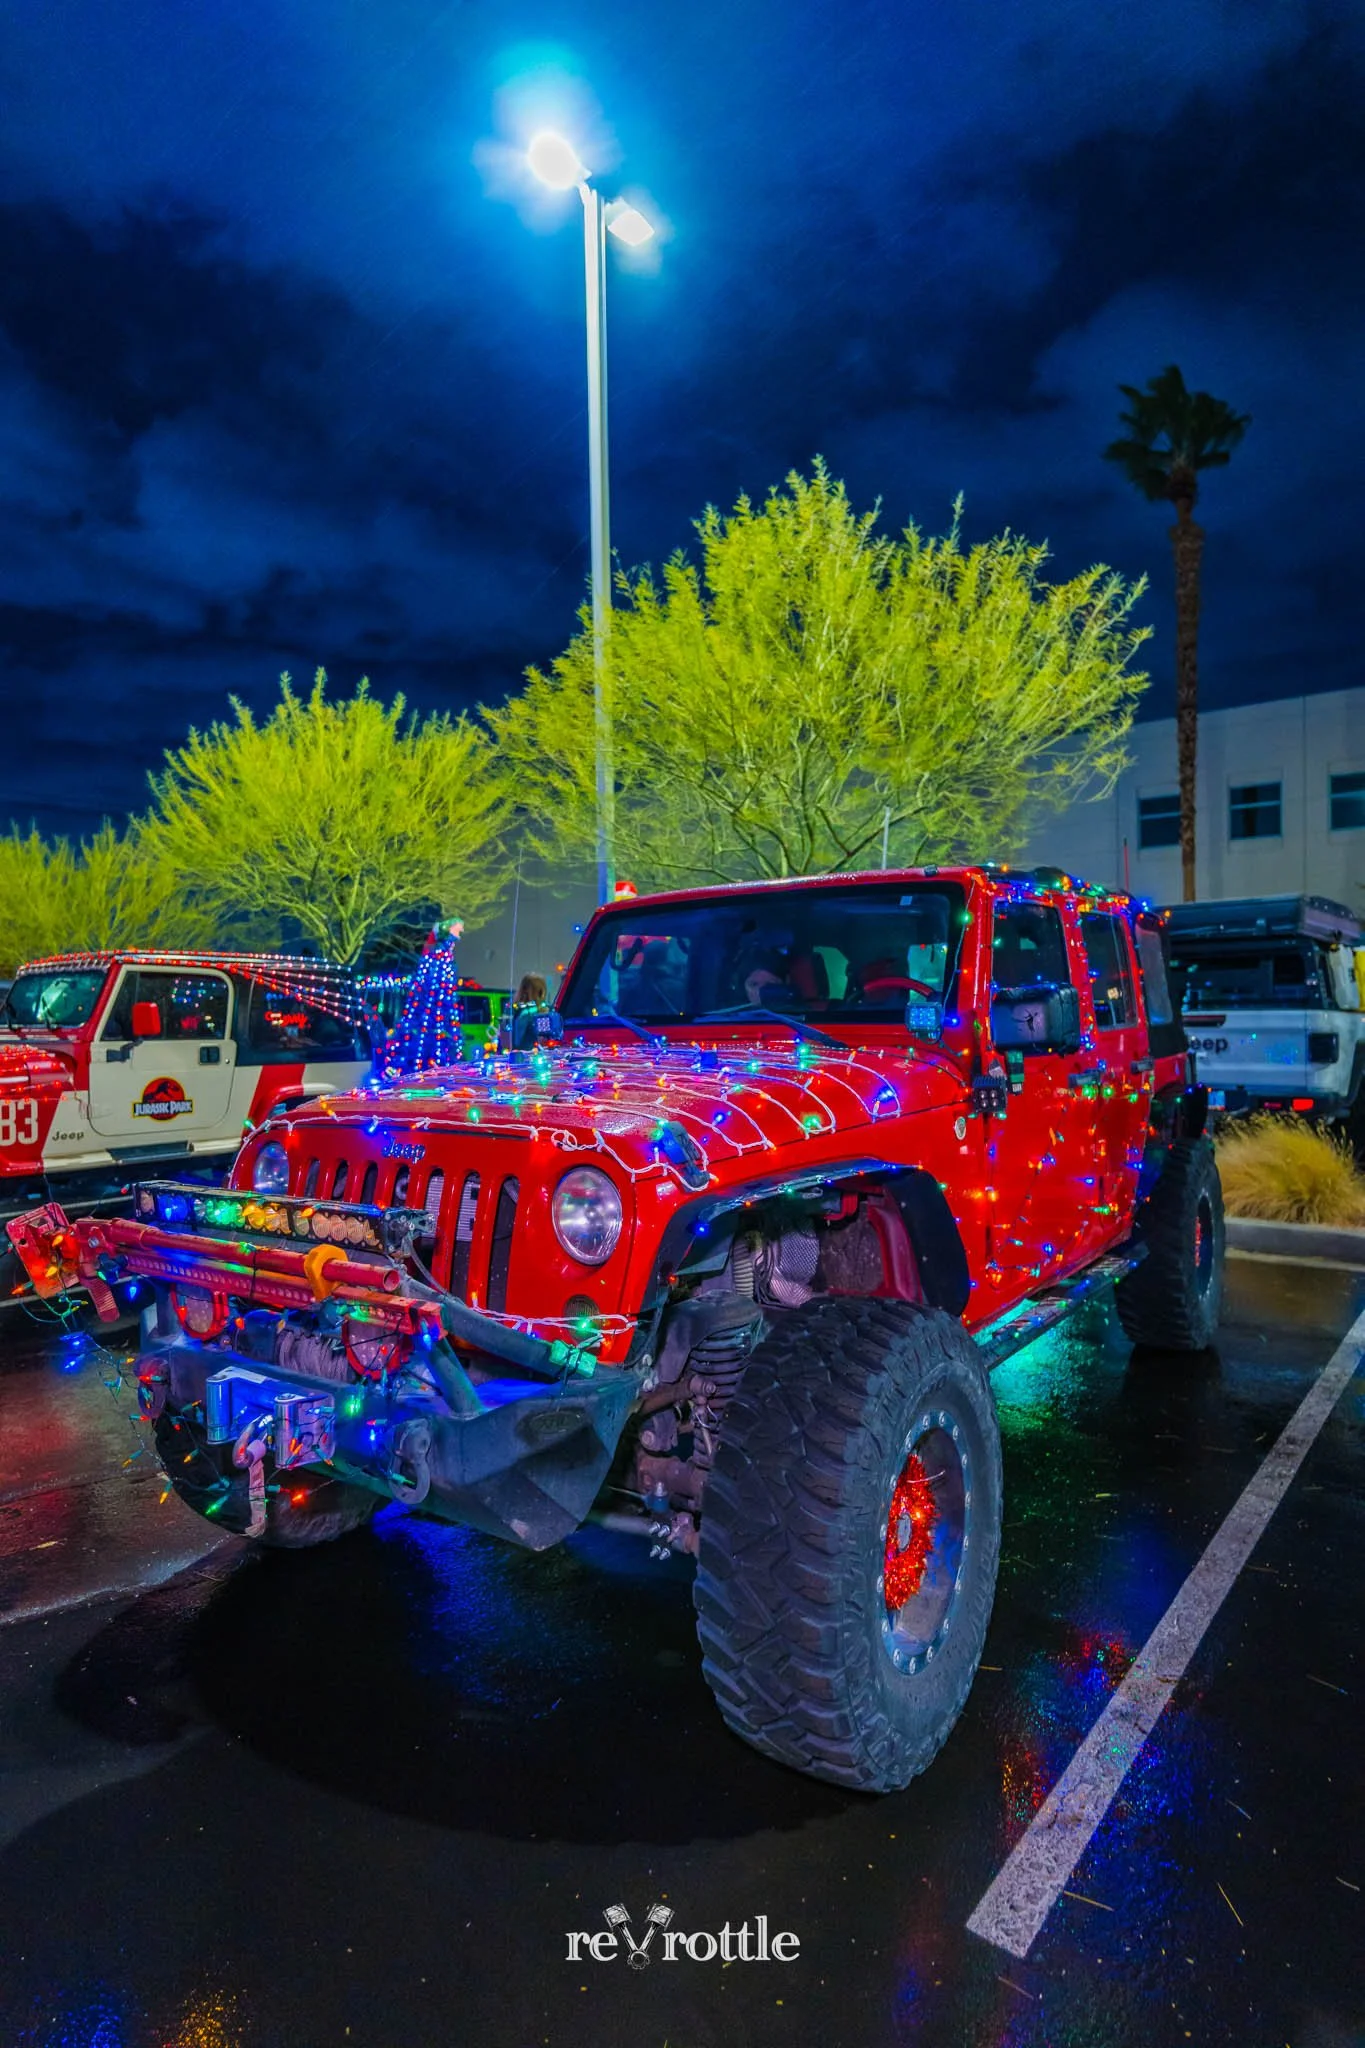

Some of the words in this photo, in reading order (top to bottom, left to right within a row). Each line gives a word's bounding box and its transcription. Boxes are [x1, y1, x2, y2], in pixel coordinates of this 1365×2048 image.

[1189, 1037, 1228, 1055] eep
[135, 1102, 169, 1116] JURASSIC
[170, 1101, 192, 1113] PARK
[52, 1131, 84, 1141] Jeep
[382, 1136, 426, 1165] Jeep
